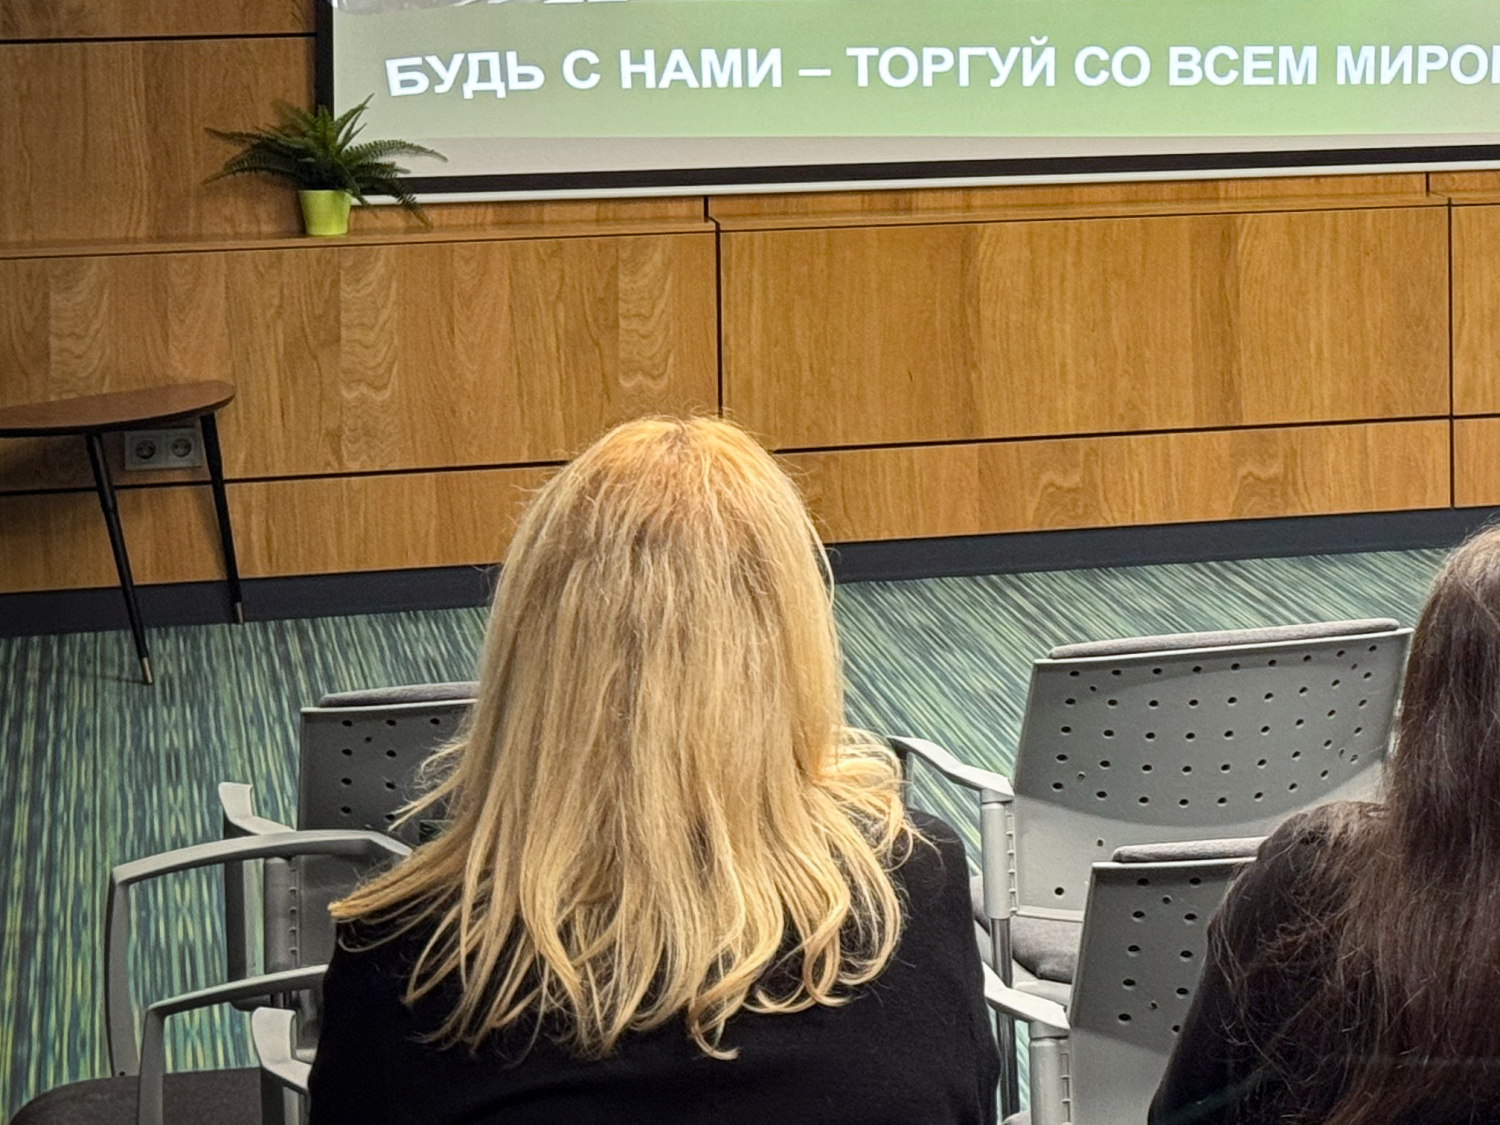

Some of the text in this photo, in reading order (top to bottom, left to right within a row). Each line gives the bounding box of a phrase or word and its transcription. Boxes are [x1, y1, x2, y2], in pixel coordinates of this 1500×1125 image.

[385, 50, 545, 99] БУДЬ
[562, 49, 600, 89] С
[619, 47, 783, 88] НАМИ
[845, 35, 1056, 88] ТОРГУЙ
[1074, 45, 1151, 87] СО
[1167, 44, 1318, 86] ВСЕМ
